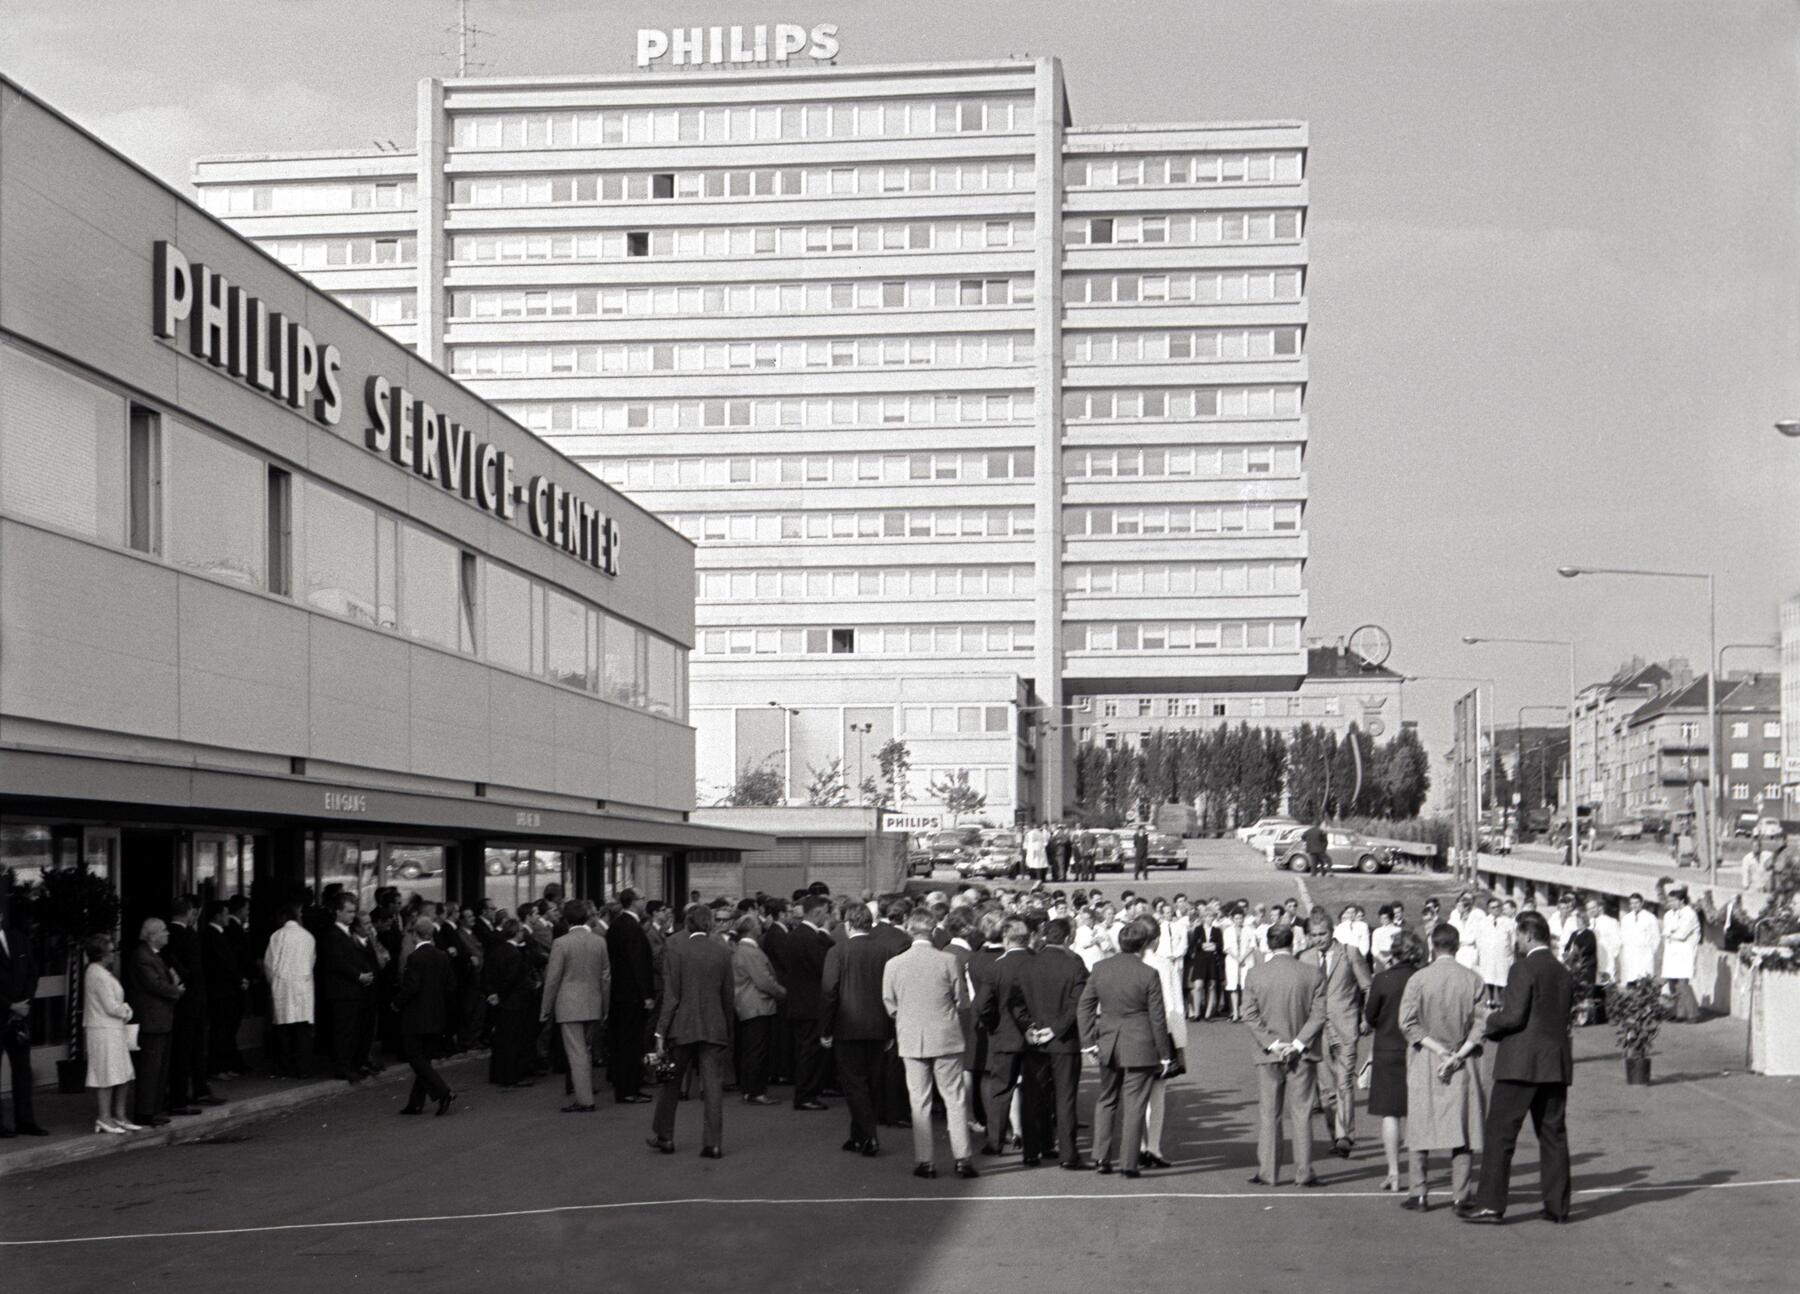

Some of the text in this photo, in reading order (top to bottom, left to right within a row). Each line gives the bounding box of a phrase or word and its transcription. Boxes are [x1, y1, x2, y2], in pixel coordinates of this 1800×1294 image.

[637, 23, 839, 67] PHILIPS
[153, 240, 620, 576] PHILIPS SERVICE-CENTER
[887, 817, 939, 828] PHILIPS
